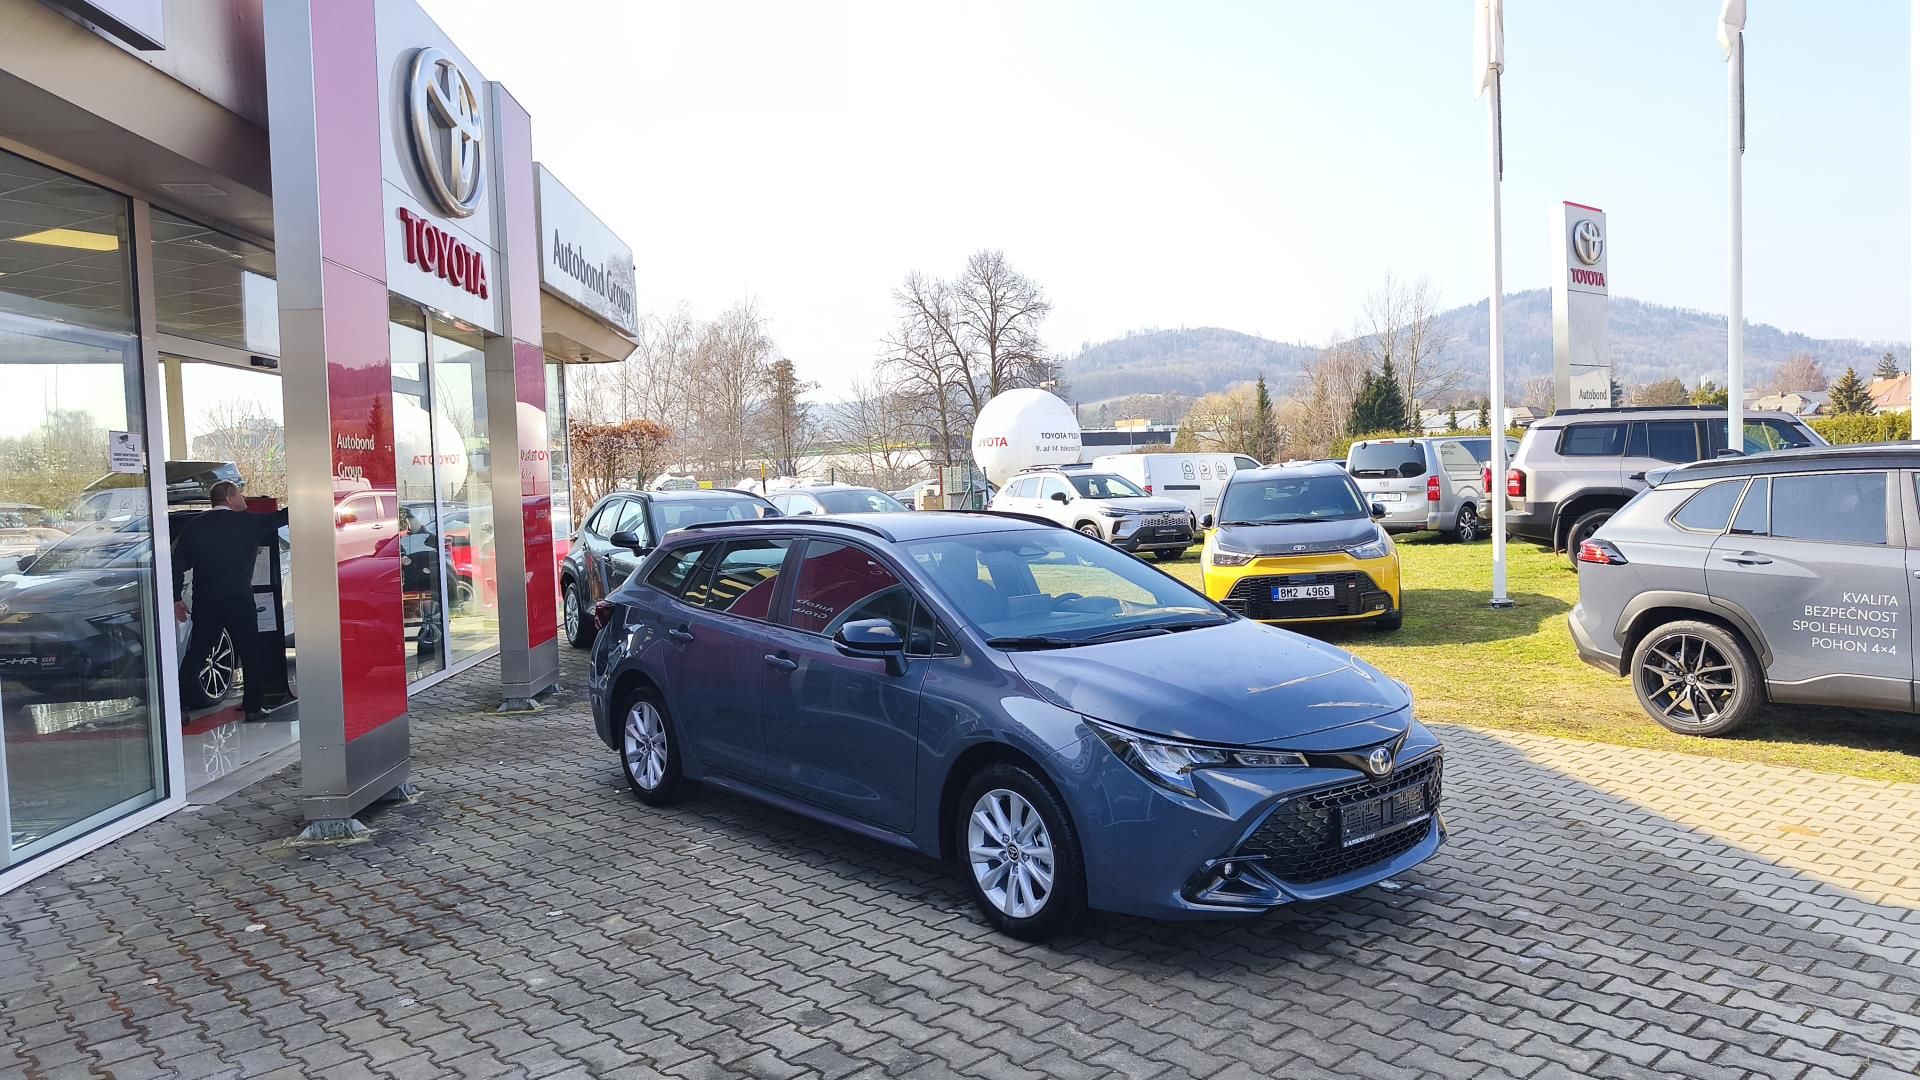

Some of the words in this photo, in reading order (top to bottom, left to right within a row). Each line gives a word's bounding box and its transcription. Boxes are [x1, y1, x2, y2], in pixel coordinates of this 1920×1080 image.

[399, 206, 489, 300] TOYOTA
[553, 228, 605, 297] Autobond
[606, 269, 631, 319] Group
[1570, 267, 1606, 287] TOYOTA
[1579, 388, 1607, 400] Autobond
[336, 432, 375, 451] Autobond
[1041, 432, 1067, 440] TOYOTA
[337, 461, 363, 478] Group
[1280, 588, 1299, 598] 8M2
[1306, 586, 1330, 597] 4966
[1842, 591, 1899, 607] KVALITA
[1804, 605, 1899, 623] BEZPEČNOST
[1792, 620, 1899, 640] SPOLEHLIVOST
[1811, 637, 1867, 653] POHON
